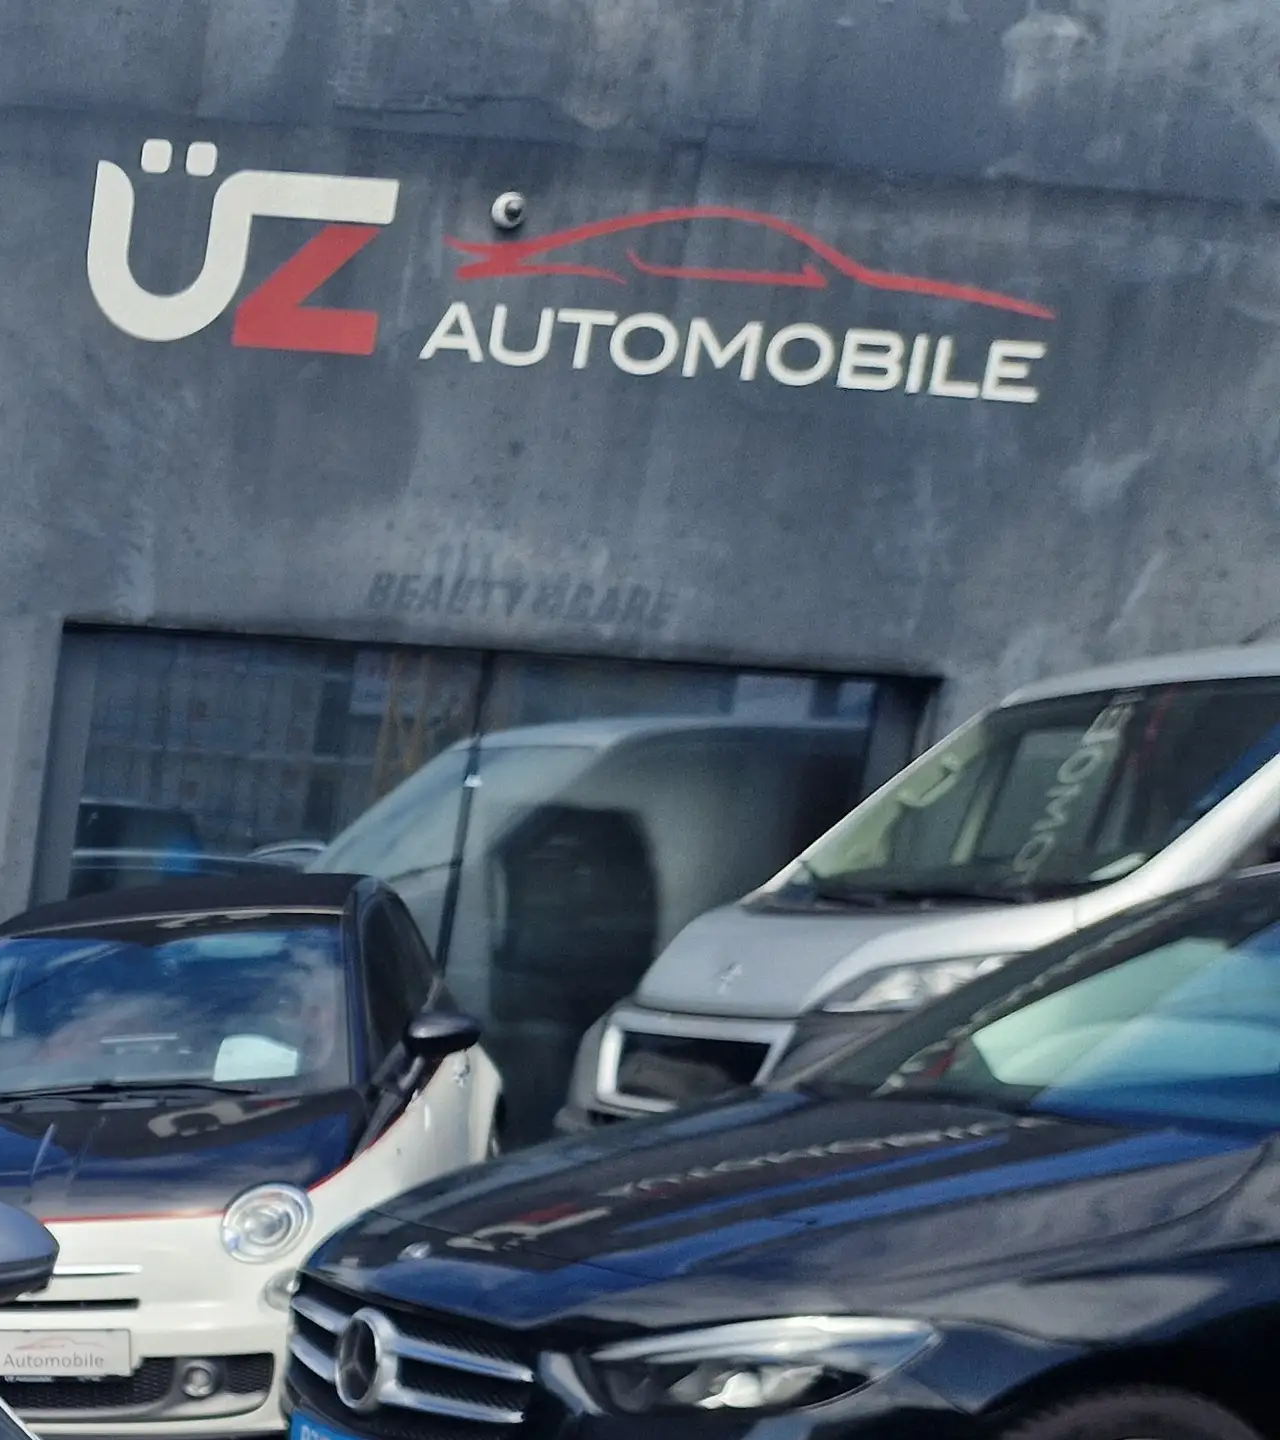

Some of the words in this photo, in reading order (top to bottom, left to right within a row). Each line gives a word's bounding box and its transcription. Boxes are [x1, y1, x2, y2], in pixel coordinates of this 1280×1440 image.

[87, 138, 400, 356] ÜZ
[419, 301, 1047, 403] AUTOMOBILE
[3, 1353, 105, 1368] Automobile
